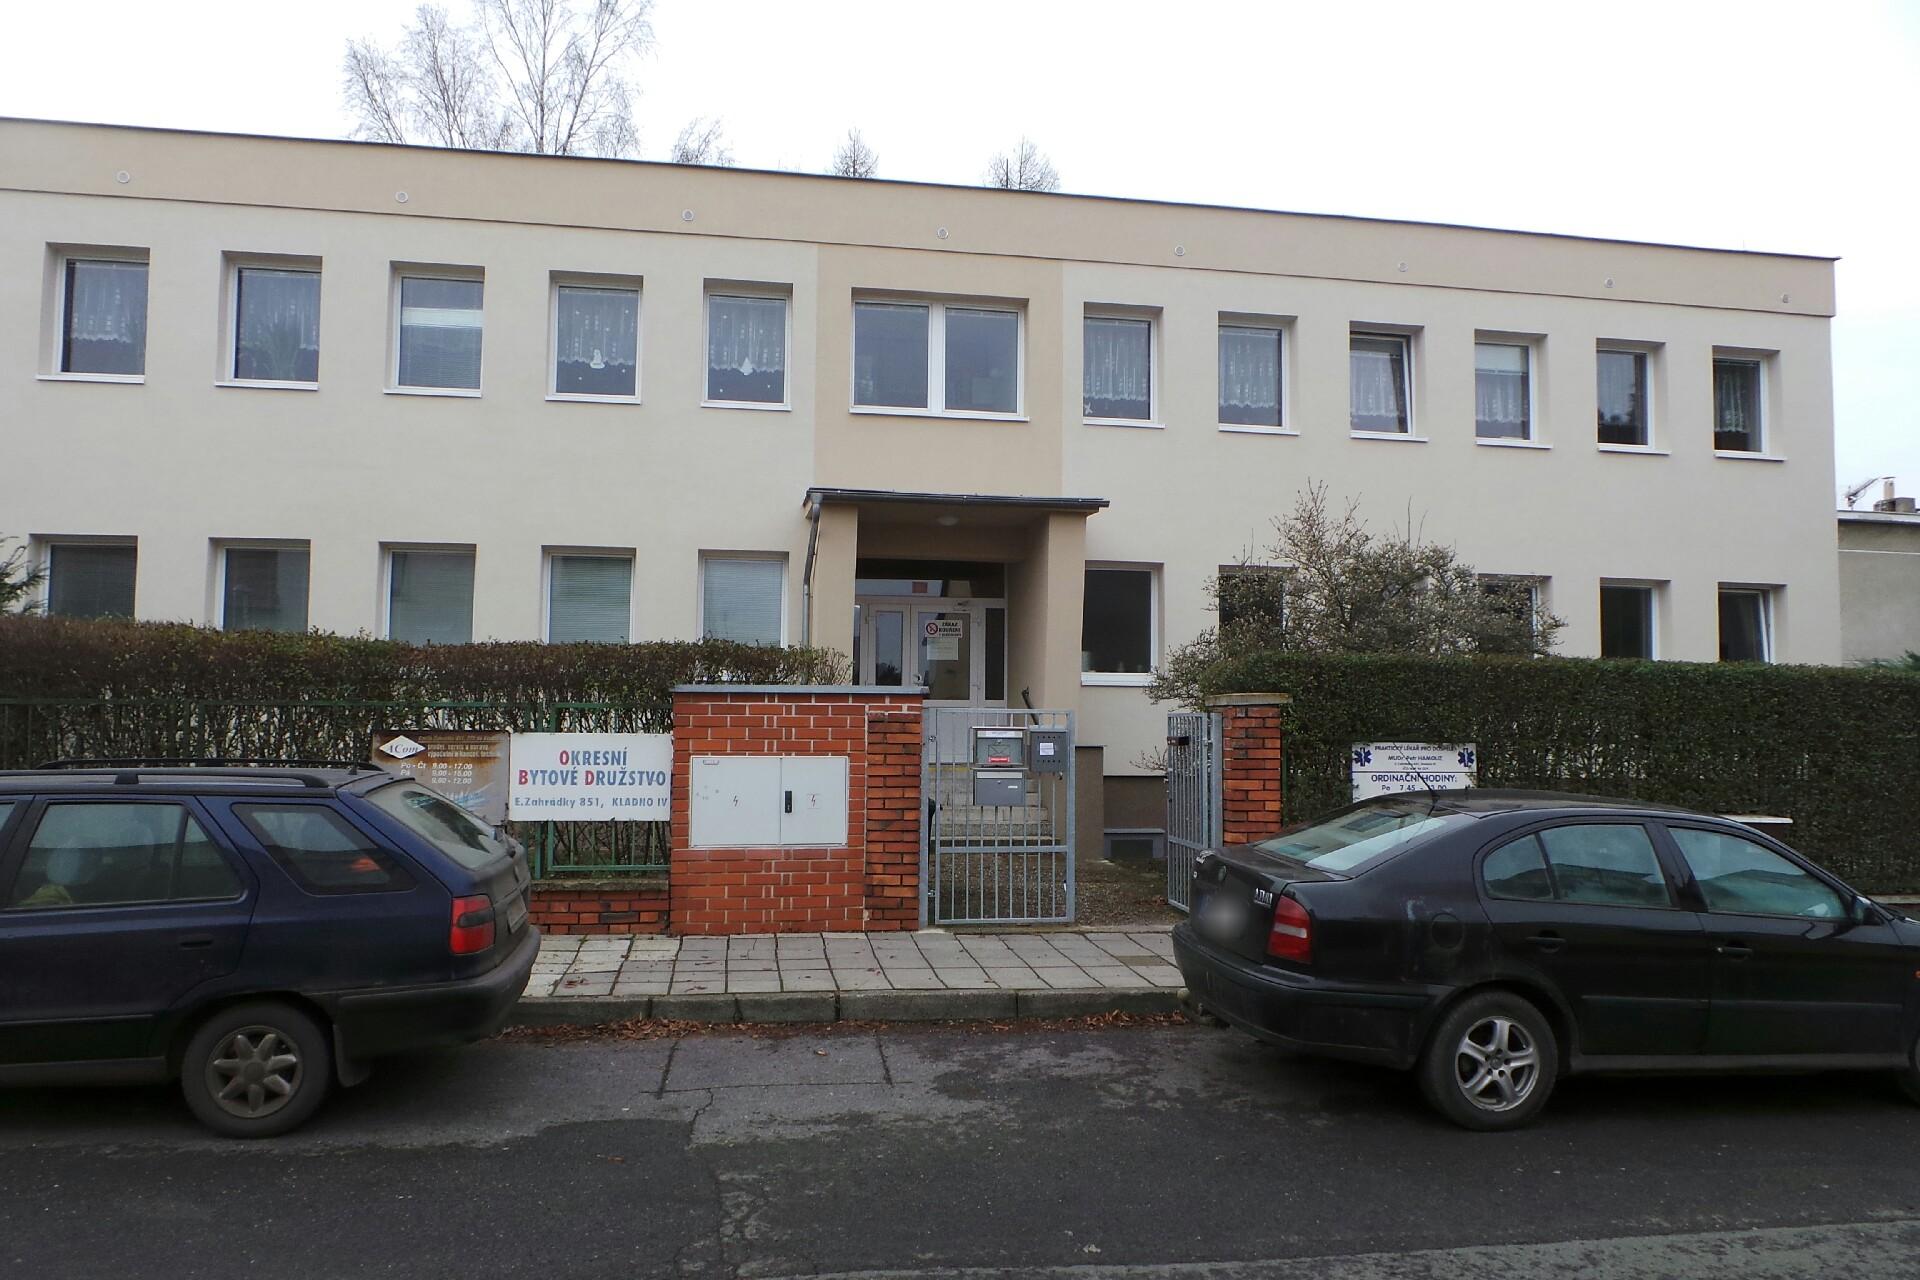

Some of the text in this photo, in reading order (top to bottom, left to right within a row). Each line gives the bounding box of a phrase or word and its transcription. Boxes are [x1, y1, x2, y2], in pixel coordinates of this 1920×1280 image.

[559, 747, 628, 766] OKRESNÍ
[518, 767, 666, 786] BYTOVÉ DRUŽSTVO
[579, 797, 604, 808] 851,
[612, 798, 654, 807] KLADNO
[657, 798, 668, 807] IV
